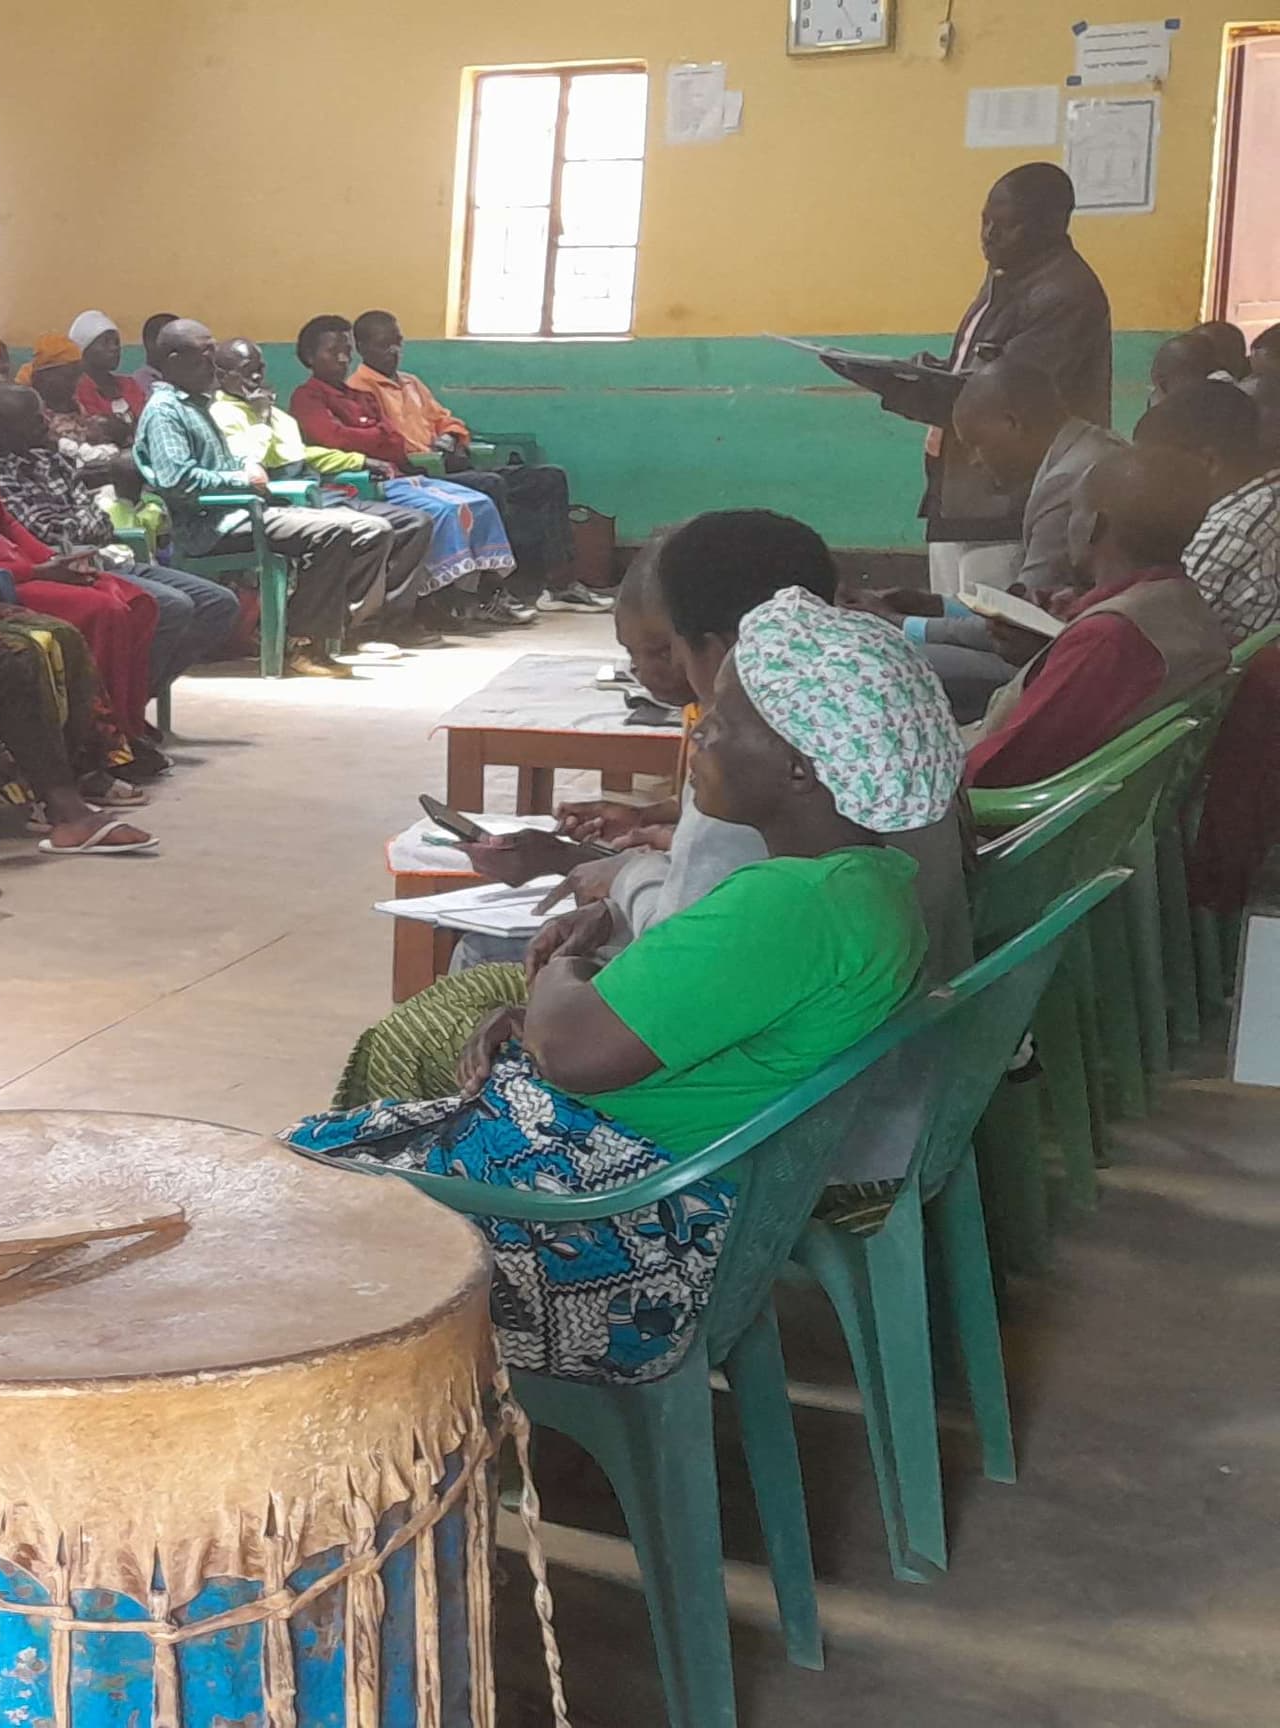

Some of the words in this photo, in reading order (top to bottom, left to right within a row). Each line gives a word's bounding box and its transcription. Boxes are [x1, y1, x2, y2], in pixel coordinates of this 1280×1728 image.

[870, 12, 877, 22] 4
[817, 30, 823, 40] 7
[835, 29, 842, 39] 6
[856, 27, 862, 38] 5
